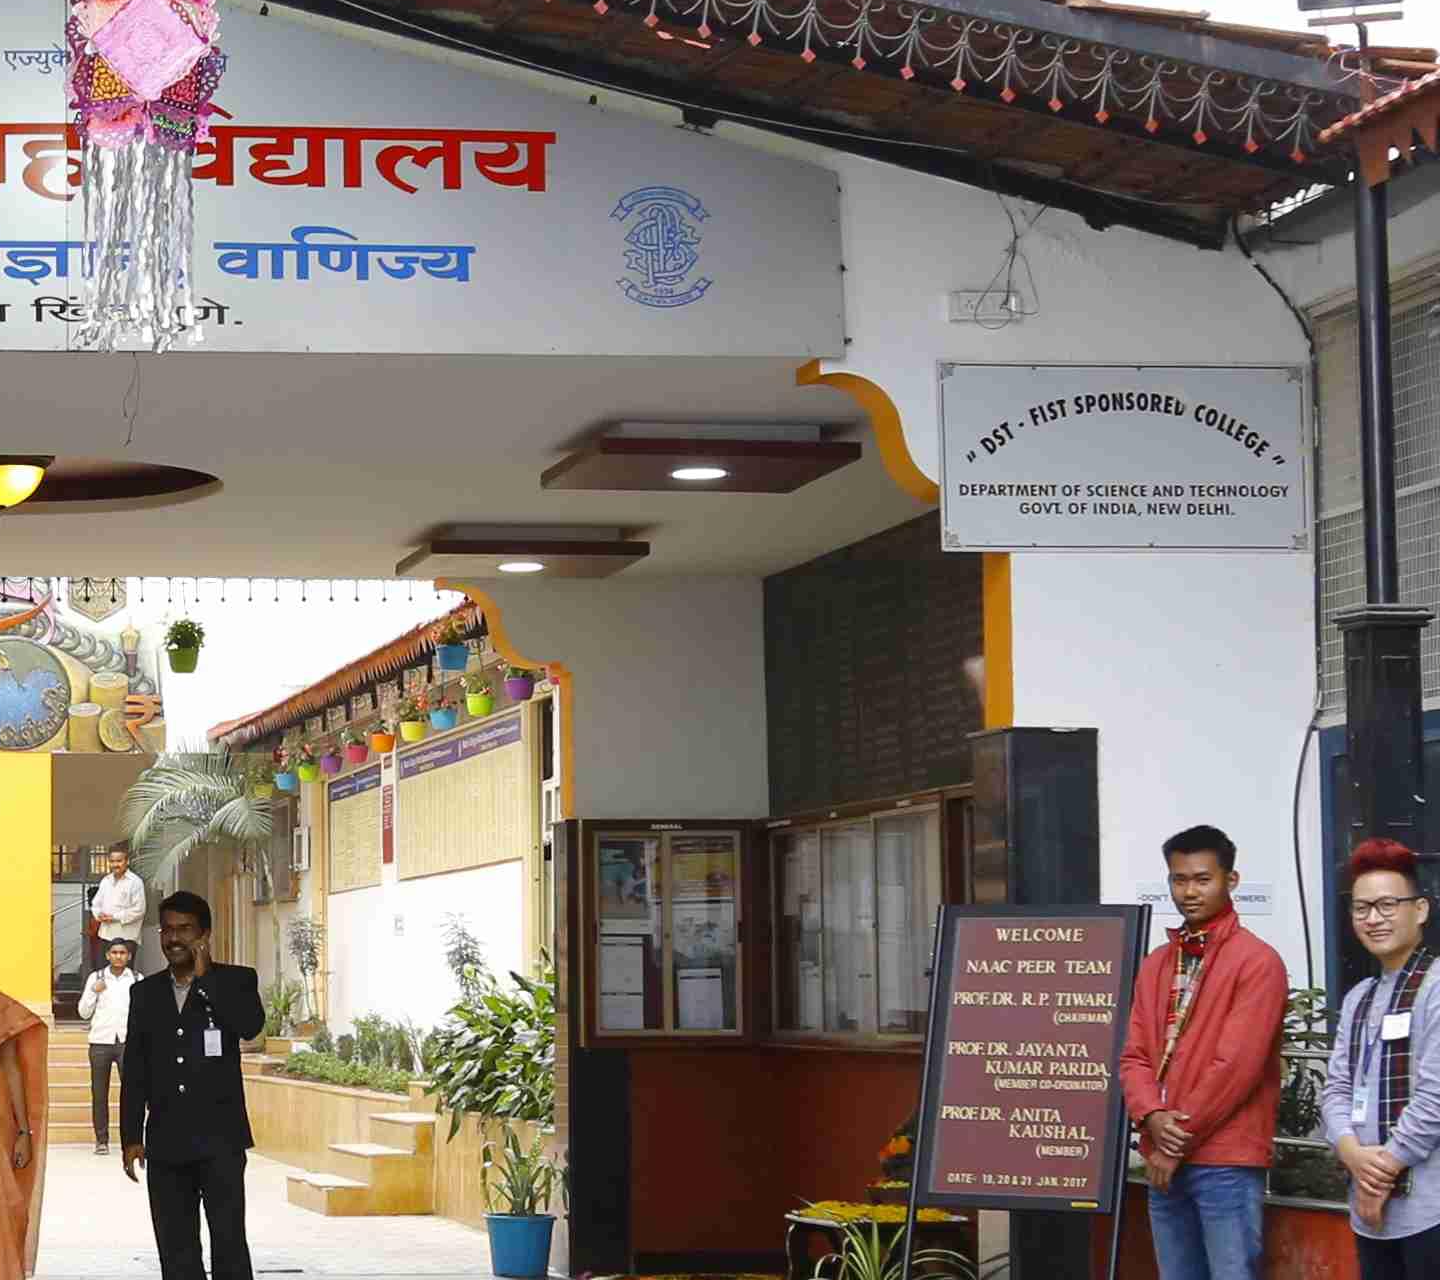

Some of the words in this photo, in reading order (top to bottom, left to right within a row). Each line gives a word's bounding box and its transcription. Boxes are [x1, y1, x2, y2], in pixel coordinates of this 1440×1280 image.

[213, 225, 477, 282] वाणिज्य
[980, 421, 1015, 456] DST
[1029, 398, 1068, 426] FIST
[1194, 404, 1271, 458] COLLEGE
[959, 483, 1057, 498] DEPARTMENT
[1062, 484, 1081, 498] OF
[1086, 484, 1148, 498] SCIENCE
[1152, 484, 1184, 498] AND
[1189, 484, 1289, 499] TECHNOLOGY
[1068, 502, 1088, 516] OF
[1092, 502, 1143, 517] INDIA,
[1147, 503, 1182, 516] NEW
[1186, 503, 1236, 517] DELHI.
[995, 927, 1085, 943] WELCOME
[966, 959, 1012, 974] NAAC
[1016, 960, 1057, 974] PEER
[1064, 960, 1112, 975] TEAM
[1015, 1042, 1089, 1058] JAYANTA
[984, 1061, 1044, 1076] KUMAR
[1009, 1107, 1062, 1124] ANITA
